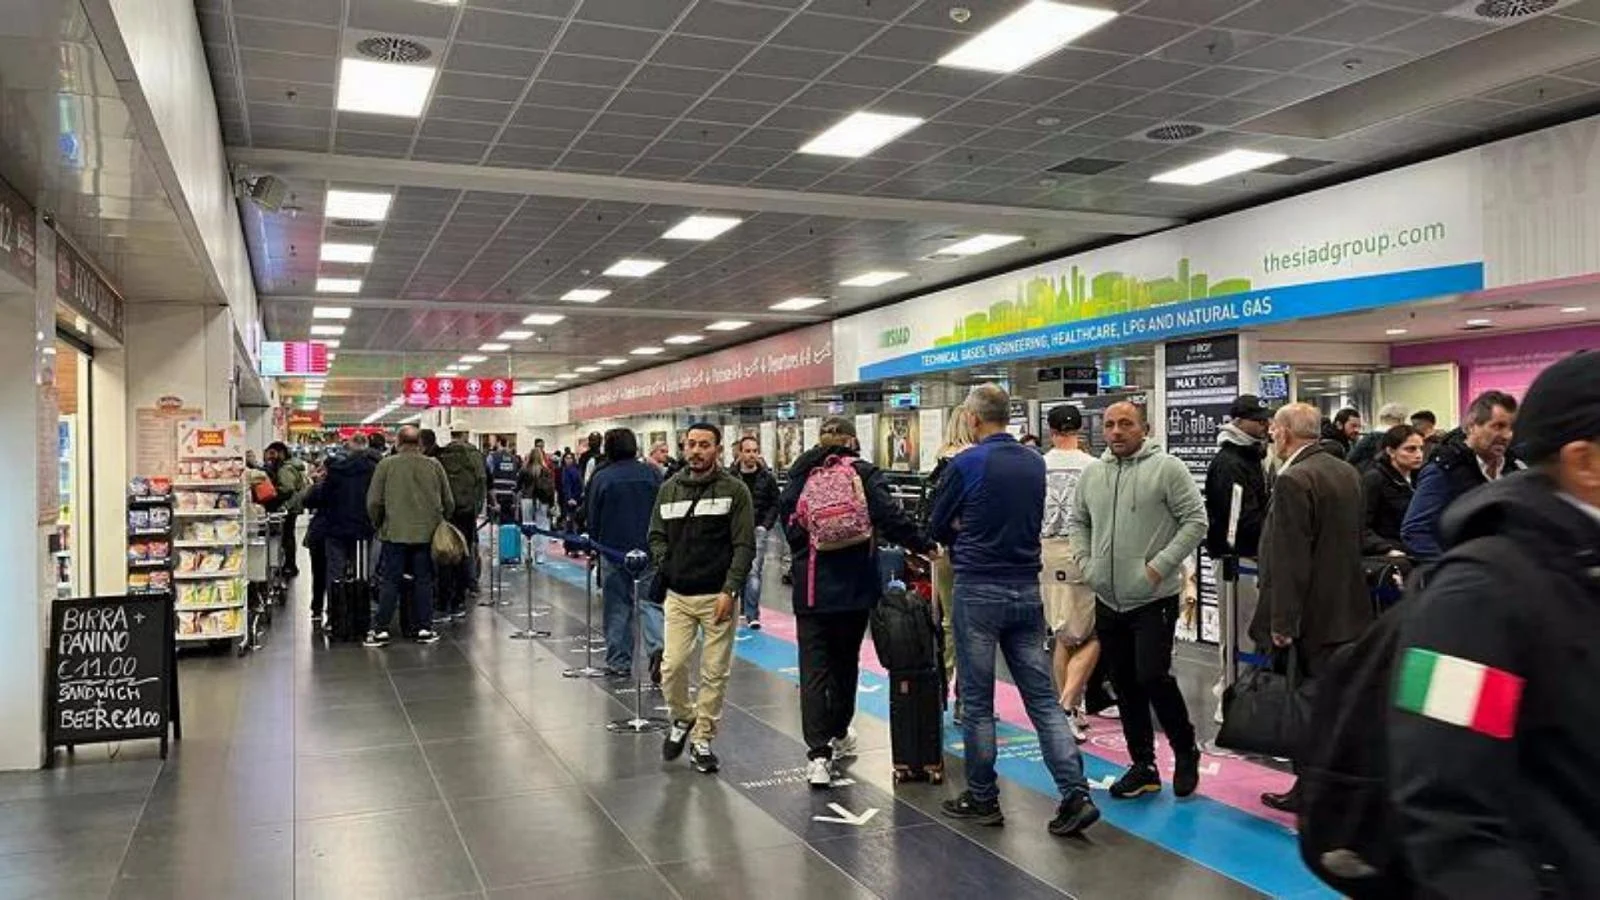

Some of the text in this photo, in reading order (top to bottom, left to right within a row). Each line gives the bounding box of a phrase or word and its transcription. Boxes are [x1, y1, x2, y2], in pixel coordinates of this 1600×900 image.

[1263, 220, 1447, 274] thesiadgroup.com
[921, 352, 960, 367] TECHNICAL
[988, 334, 1050, 357] ENGINEERING,
[1051, 322, 1121, 346] HEALTHCARE,
[1122, 317, 1147, 336] LPG
[1147, 313, 1175, 333] AND
[1176, 304, 1240, 328] NATURAL
[1241, 295, 1273, 317] GAS
[1175, 377, 1196, 389] MAX
[63, 605, 146, 631] BIRRA +
[59, 631, 130, 655] PANINO
[58, 683, 140, 703] SANDWICH
[60, 707, 111, 730] BEER
